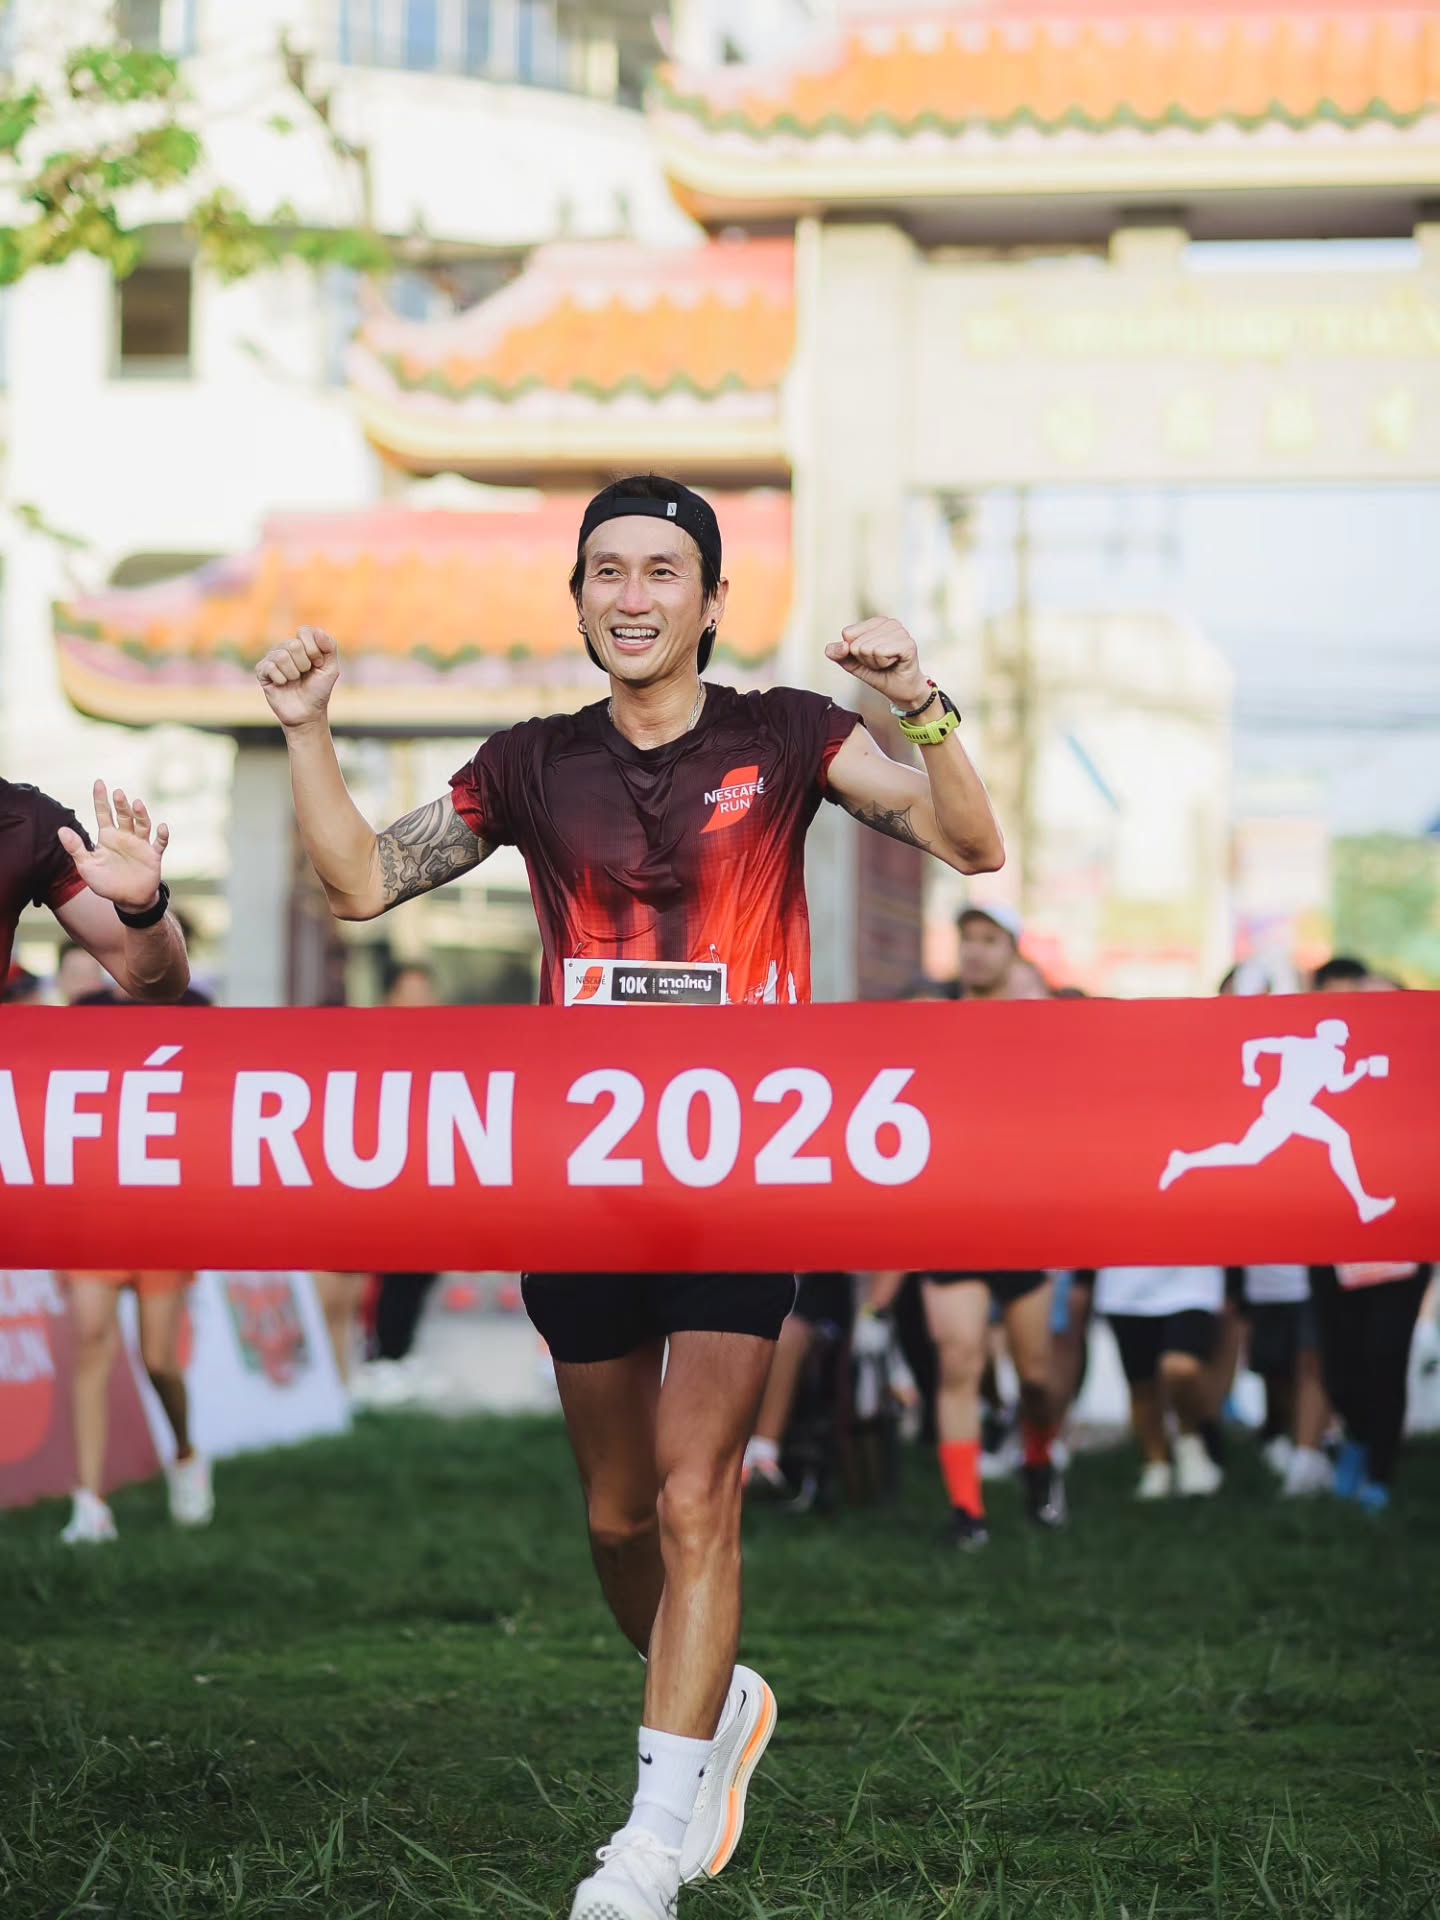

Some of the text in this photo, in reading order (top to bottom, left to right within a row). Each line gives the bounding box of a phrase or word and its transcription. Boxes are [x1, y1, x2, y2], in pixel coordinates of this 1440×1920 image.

[704, 777, 765, 805] NESCAFÉ
[720, 799, 751, 814] RUN
[618, 976, 648, 994] 10K
[658, 974, 712, 992] หาดใหญ่
[231, 1071, 515, 1190] RUN
[566, 1067, 931, 1188] 2026
